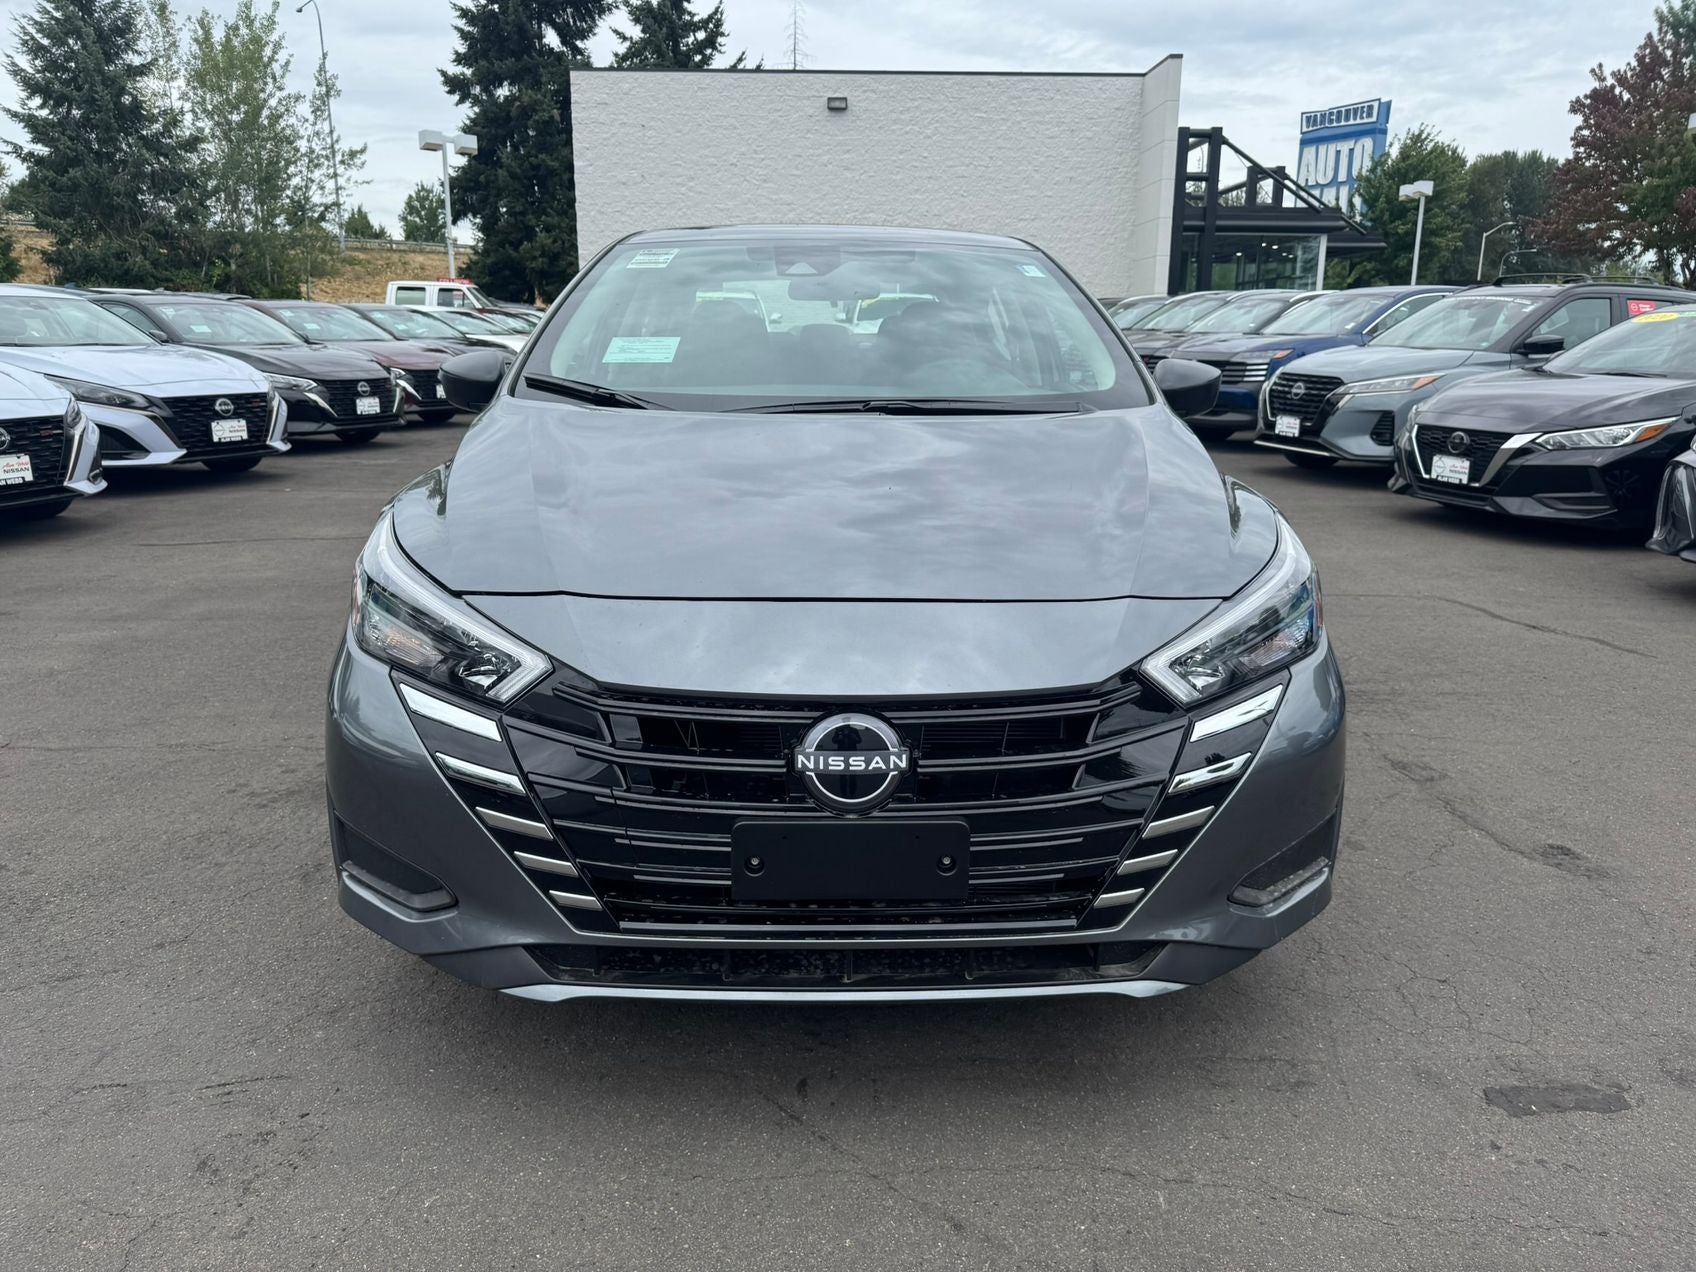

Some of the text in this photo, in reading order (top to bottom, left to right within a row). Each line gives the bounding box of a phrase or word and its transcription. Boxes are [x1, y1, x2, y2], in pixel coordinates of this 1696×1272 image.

[1305, 104, 1375, 129] VANCOUVER
[1298, 137, 1374, 187] AUTO
[3, 466, 30, 474] NISSAN
[797, 754, 907, 771] NISSAN
